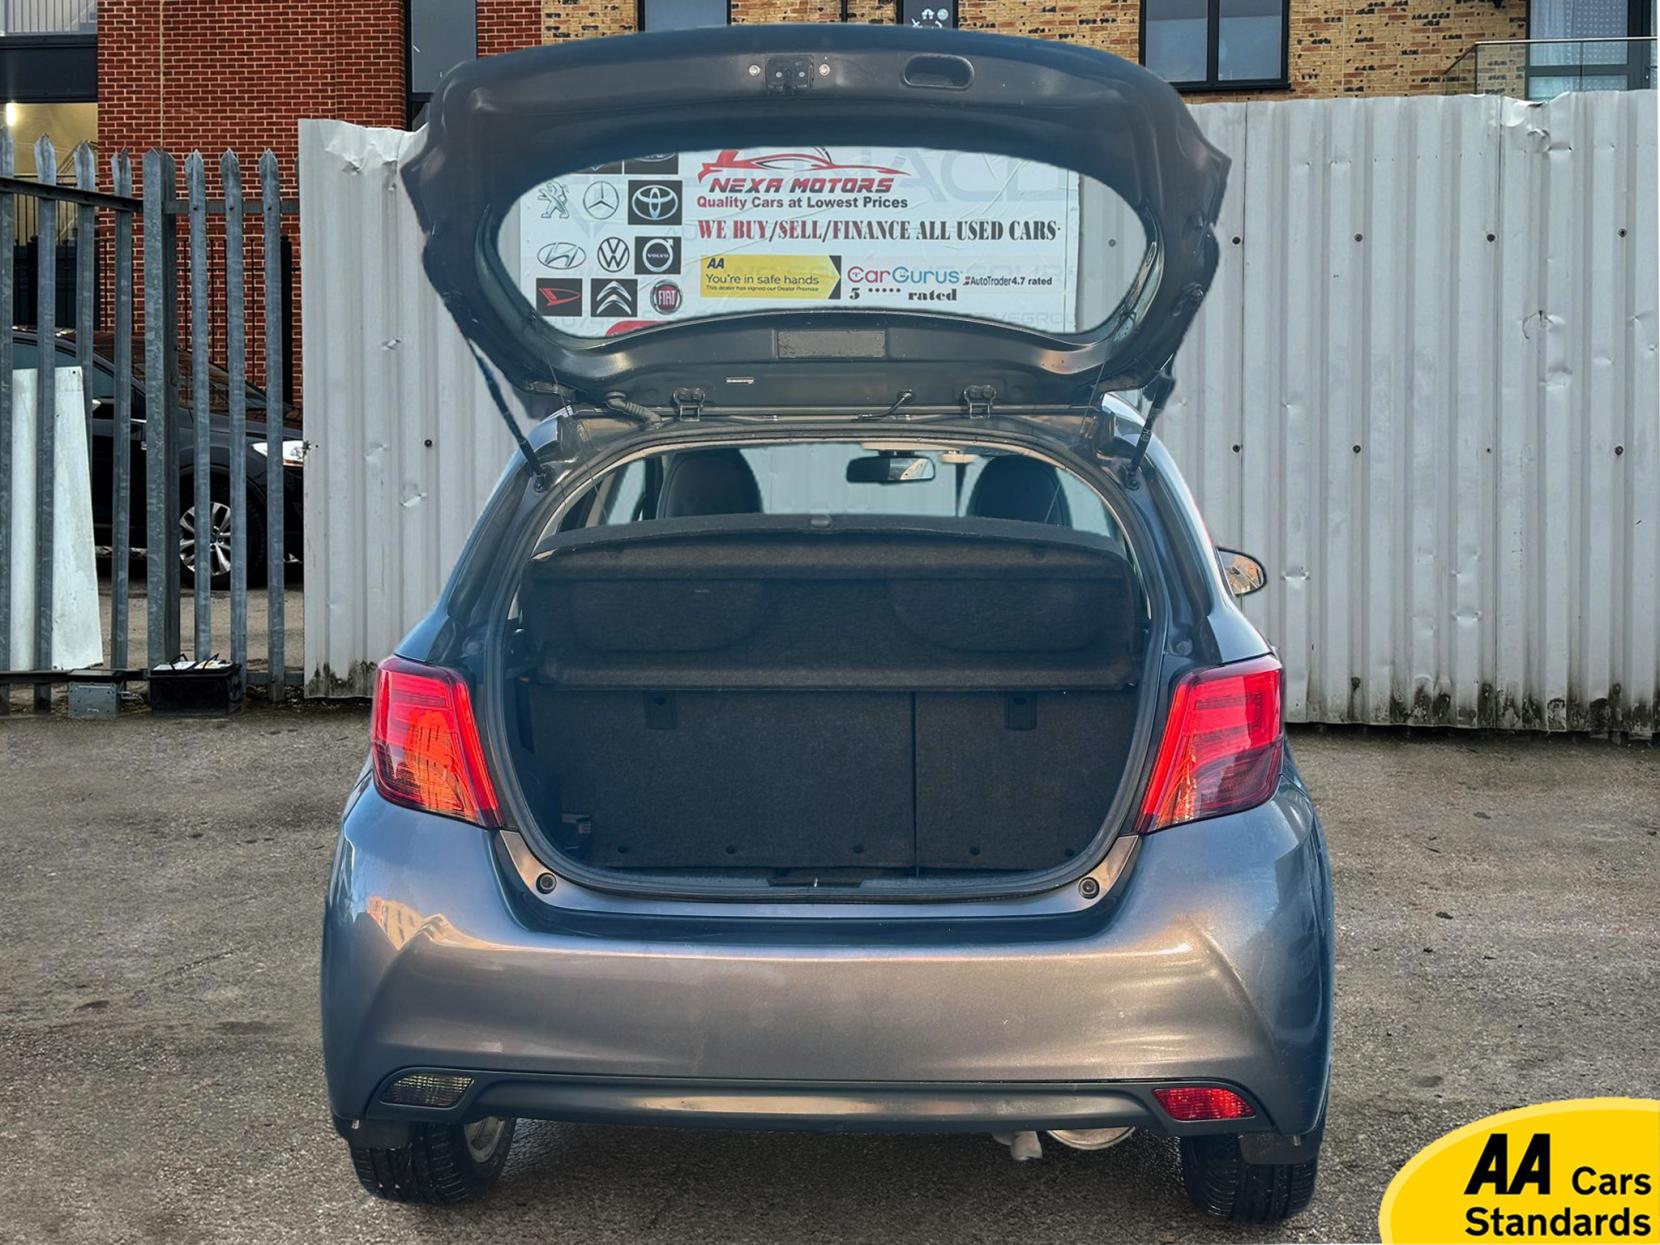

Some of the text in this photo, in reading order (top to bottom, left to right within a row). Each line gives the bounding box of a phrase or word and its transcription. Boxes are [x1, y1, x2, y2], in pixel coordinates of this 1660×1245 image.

[709, 178, 894, 193] NEXA MOTORS
[697, 196, 908, 211] Quality Cars at Lowest Prices
[698, 220, 727, 239] WE
[916, 220, 950, 240] ALL
[956, 220, 1004, 240] USED
[706, 258, 725, 269] AA
[706, 274, 820, 285] You're in safe hands
[847, 266, 960, 284] CarGurus
[1028, 277, 1053, 286] rated
[658, 290, 677, 306] FIAT
[849, 287, 957, 301] 5 rated
